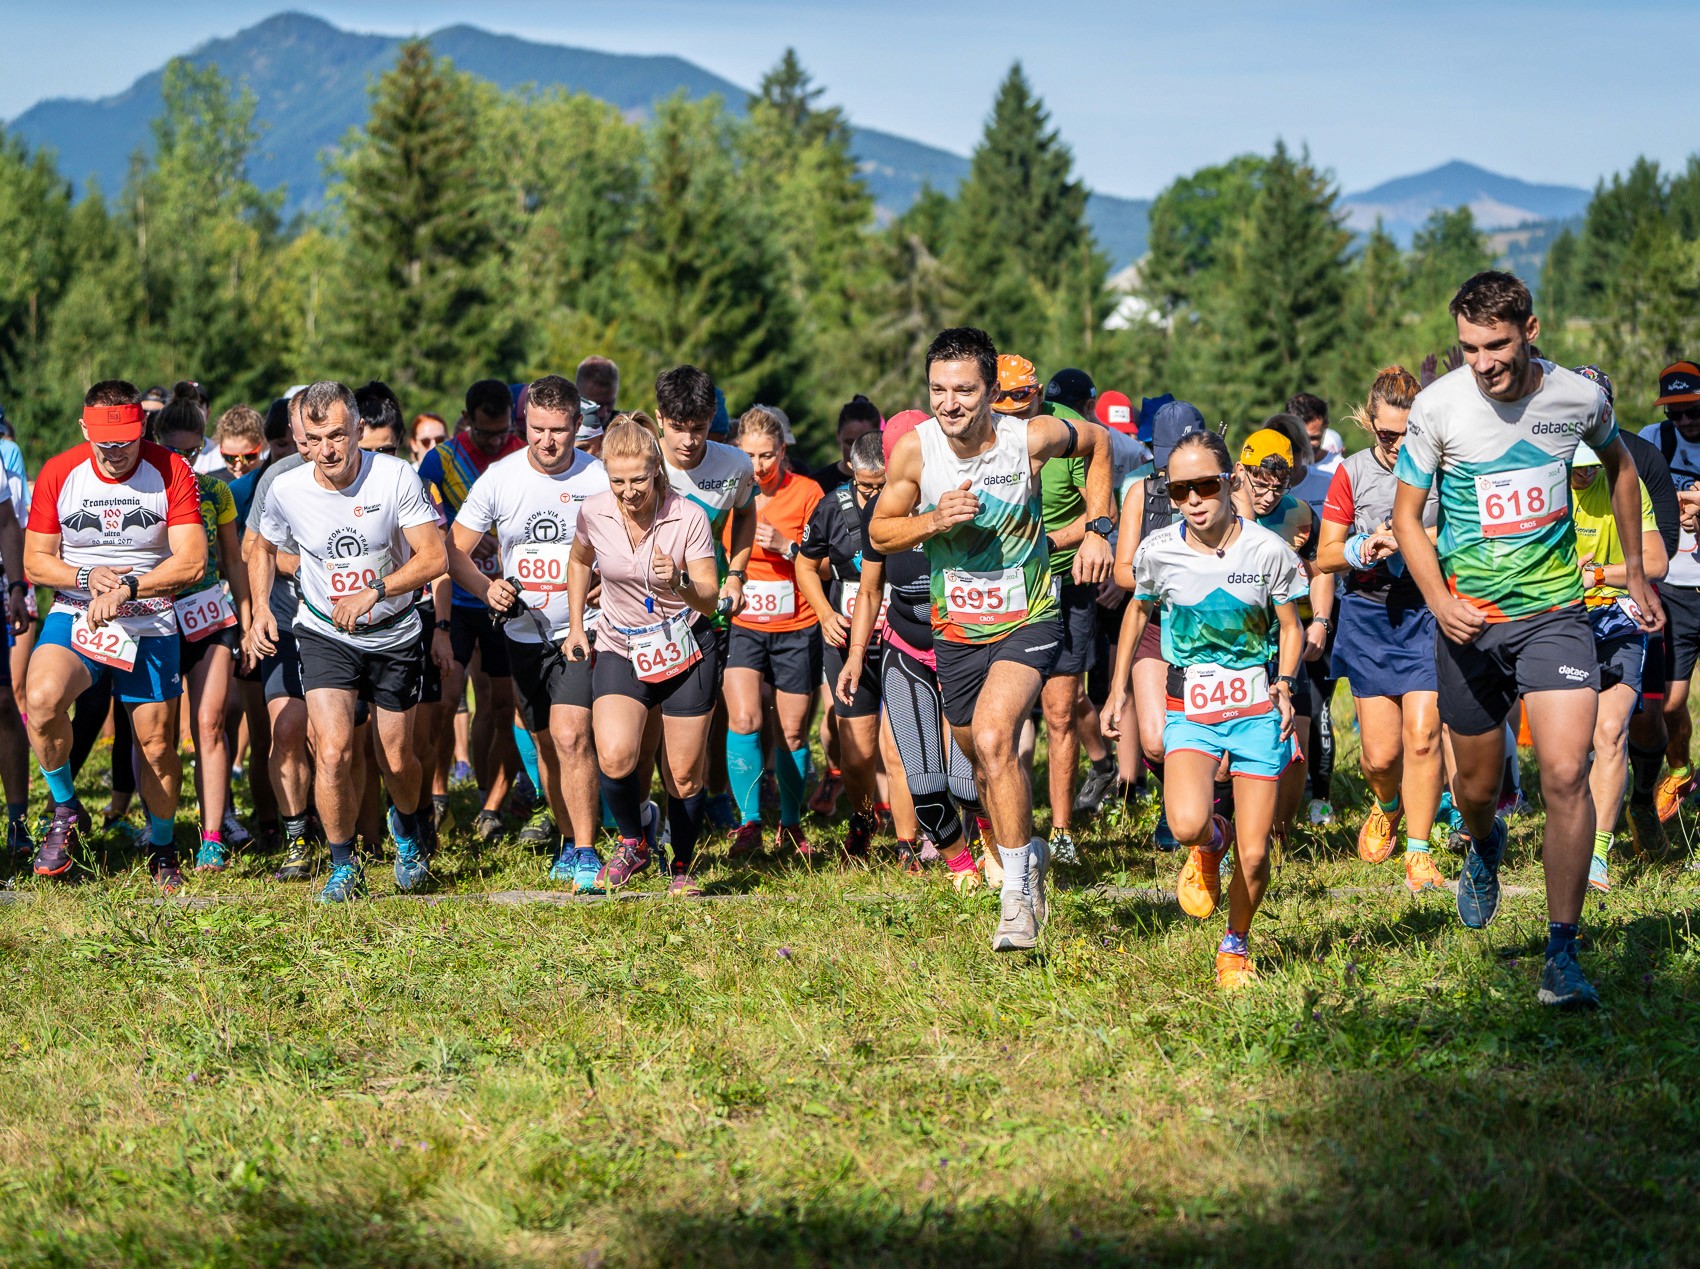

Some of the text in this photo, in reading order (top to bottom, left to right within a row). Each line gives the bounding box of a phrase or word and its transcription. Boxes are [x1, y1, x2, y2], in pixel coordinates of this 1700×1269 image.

[82, 496, 141, 508] Transylvania
[363, 503, 382, 511] Maraton
[1485, 486, 1545, 520] 618
[103, 508, 121, 519] 100
[547, 509, 559, 519] VIA
[105, 520, 119, 530] 50
[345, 526, 358, 535] VIA
[1519, 521, 1537, 530] CROS
[518, 558, 561, 579] 680
[331, 568, 377, 593] 620
[950, 586, 1004, 610] 695
[183, 600, 220, 630] 619
[76, 628, 120, 654] 642
[94, 654, 108, 662] CROS
[636, 642, 682, 673] 643
[666, 667, 679, 677] CROS
[1190, 677, 1248, 710] 648
[1222, 710, 1239, 719] CROS
[1319, 736, 1331, 776] NIKE
